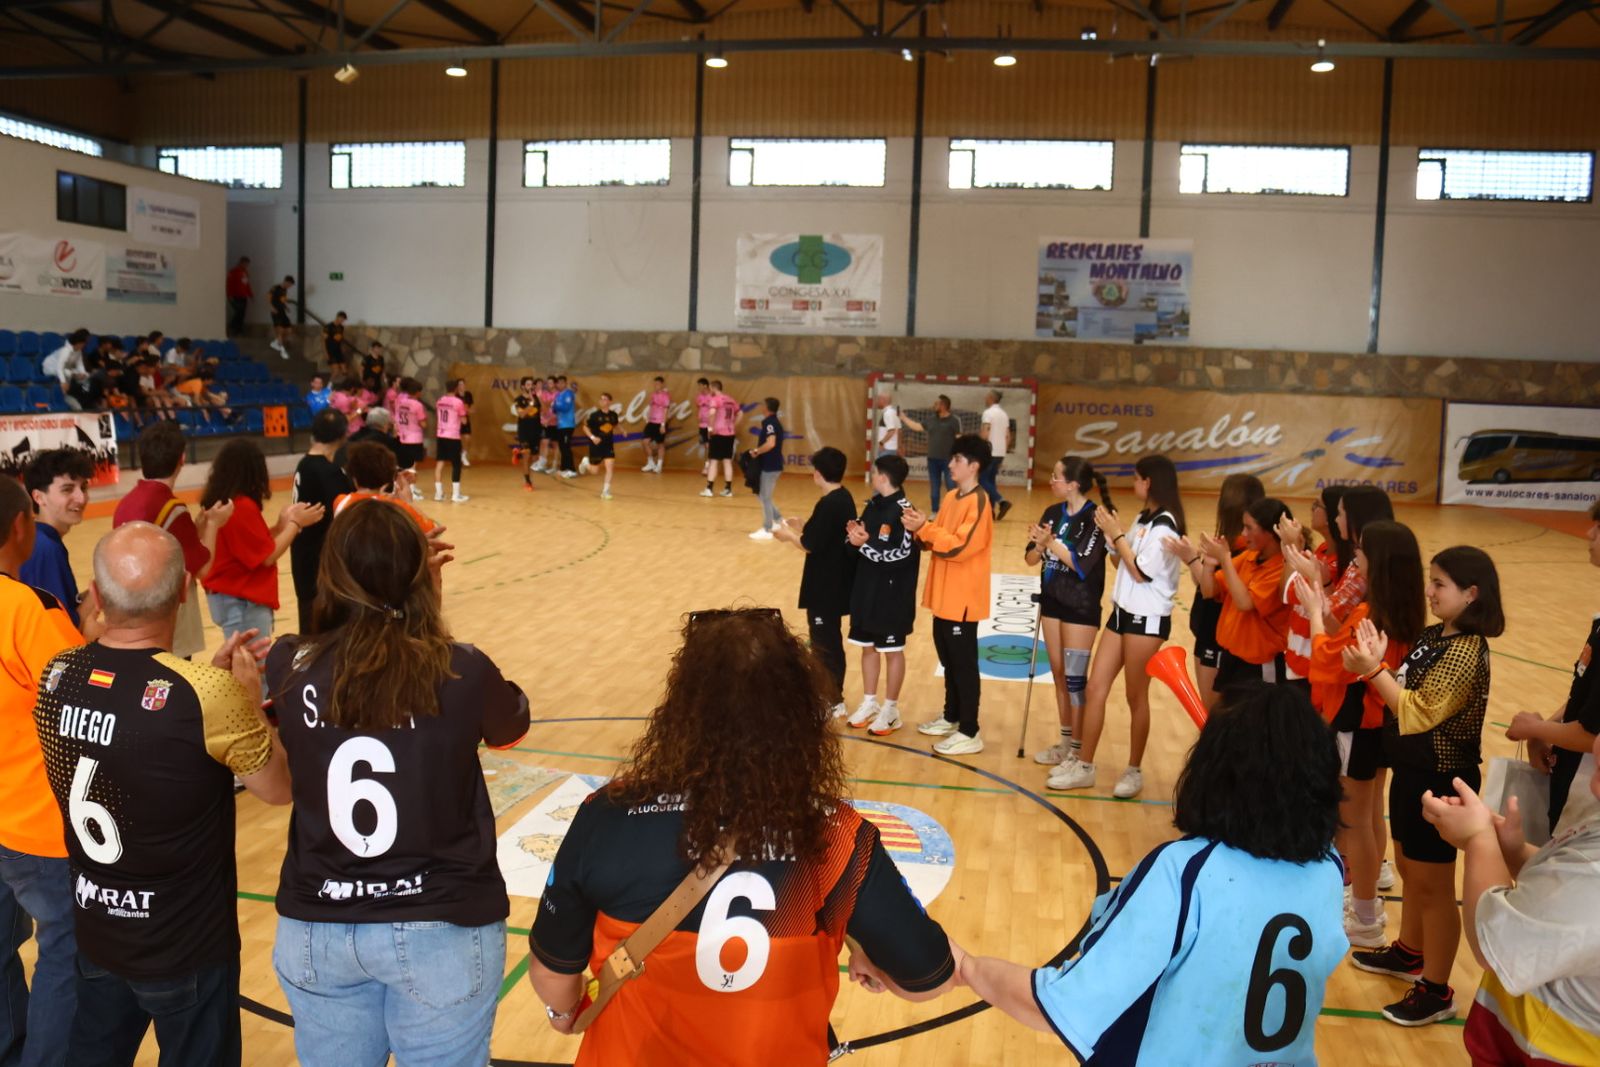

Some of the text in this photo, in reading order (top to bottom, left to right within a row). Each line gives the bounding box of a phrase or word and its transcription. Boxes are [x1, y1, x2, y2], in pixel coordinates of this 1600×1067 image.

[1046, 242, 1143, 261] RECICLAJES
[1089, 263, 1183, 281] MONTALVO
[1054, 402, 1154, 417] AUTOCARES
[1066, 411, 1281, 459] Sanalón
[59, 705, 116, 747] DIEGO
[69, 755, 123, 865] 6
[327, 736, 398, 858] 6
[695, 871, 776, 993] 6
[1244, 912, 1313, 1053] 6
